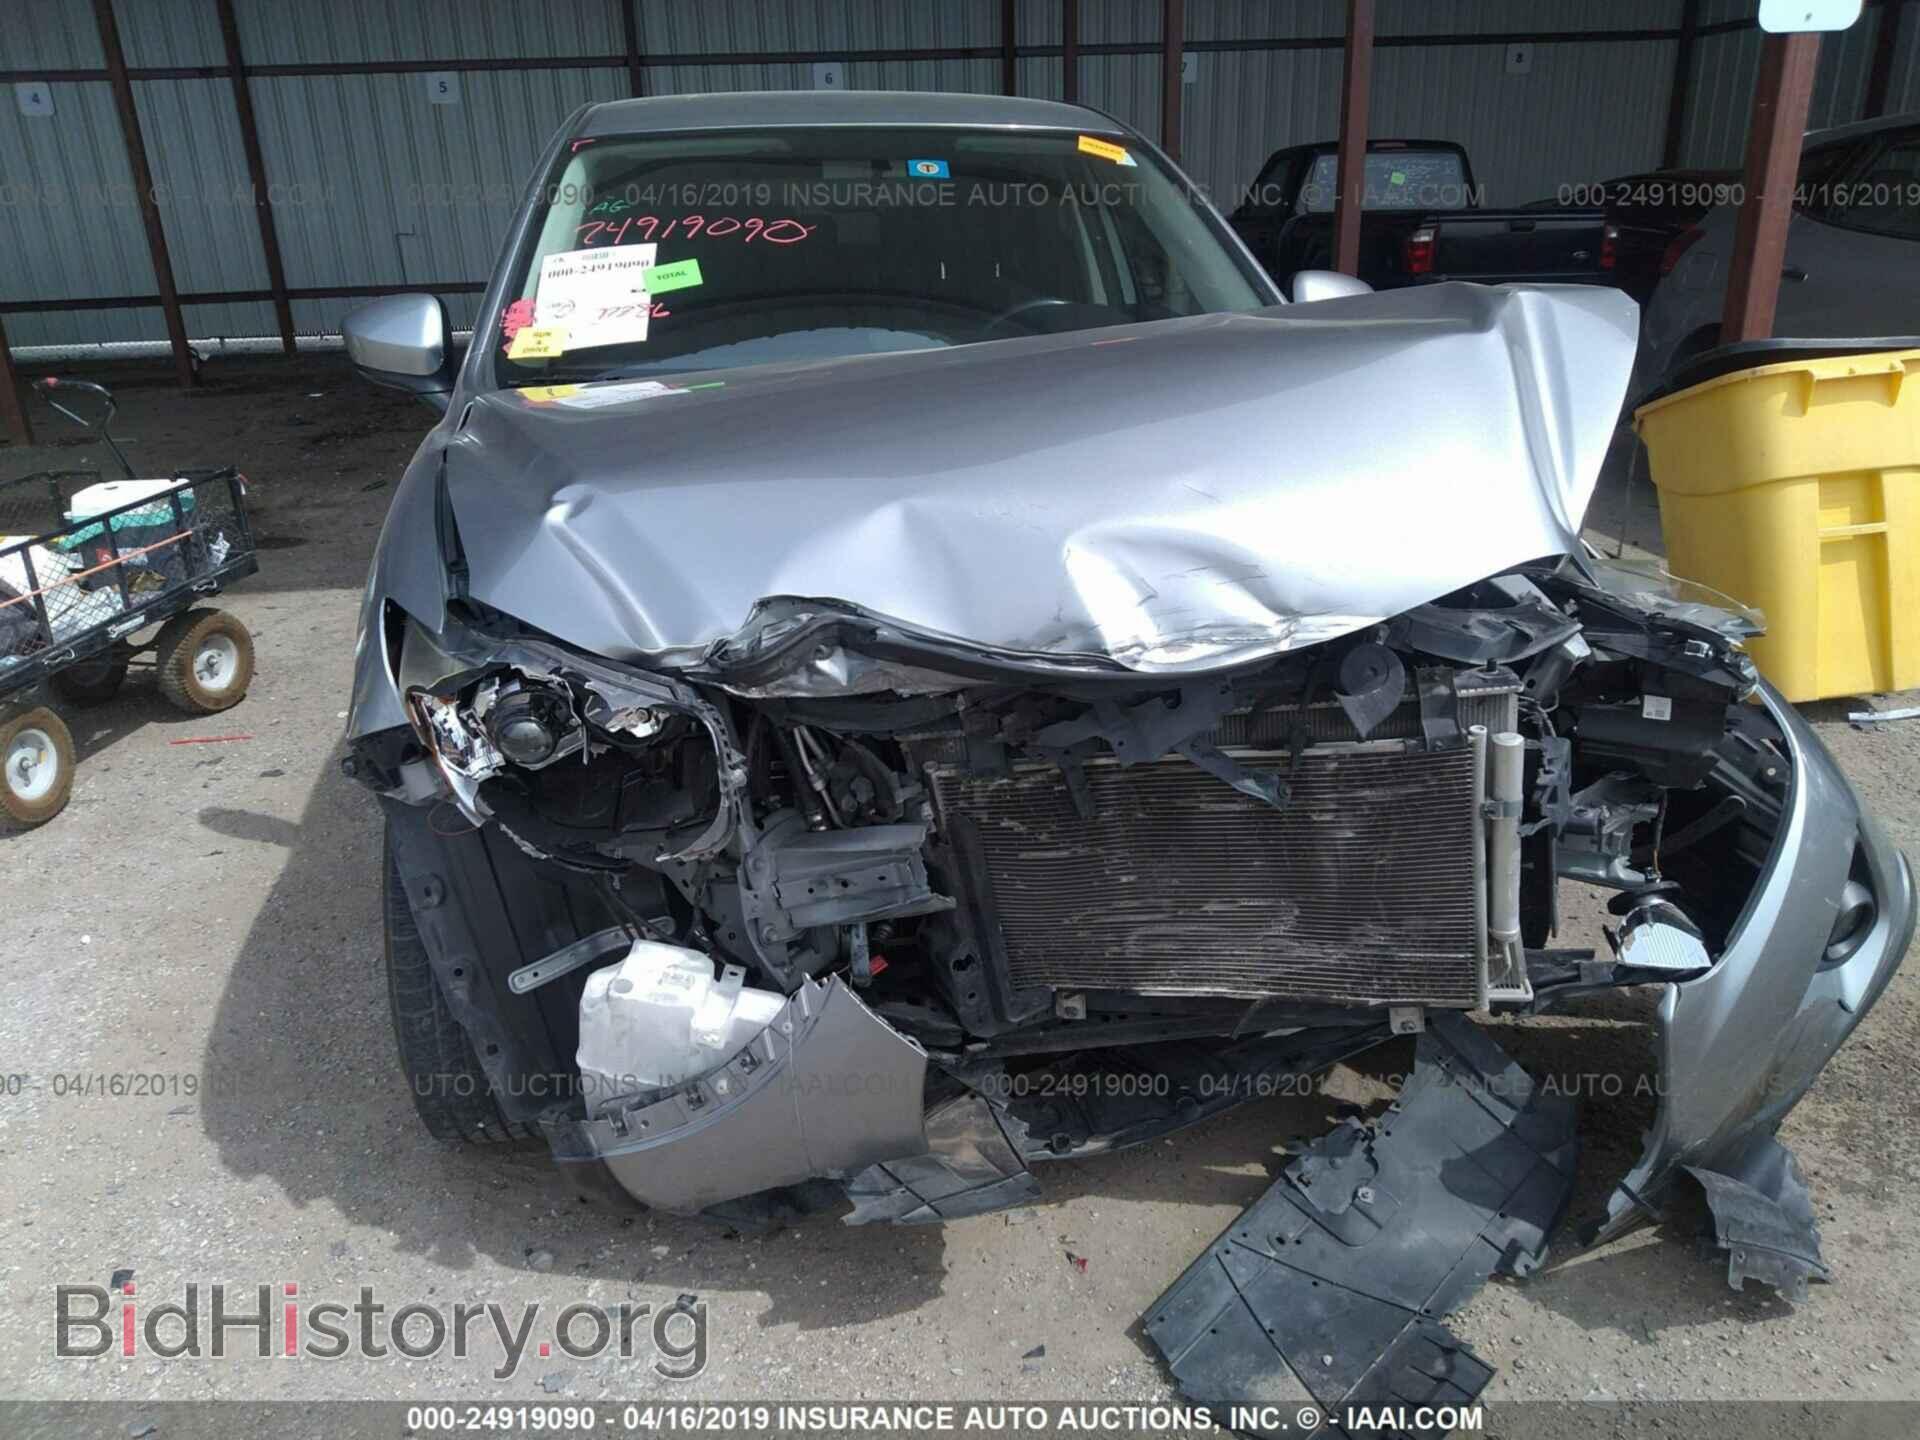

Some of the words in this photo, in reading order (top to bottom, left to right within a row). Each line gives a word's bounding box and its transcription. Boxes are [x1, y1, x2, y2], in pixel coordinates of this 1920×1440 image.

[825, 72, 833, 85] 6
[439, 81, 447, 93] 5
[656, 270, 687, 281] TOTAL
